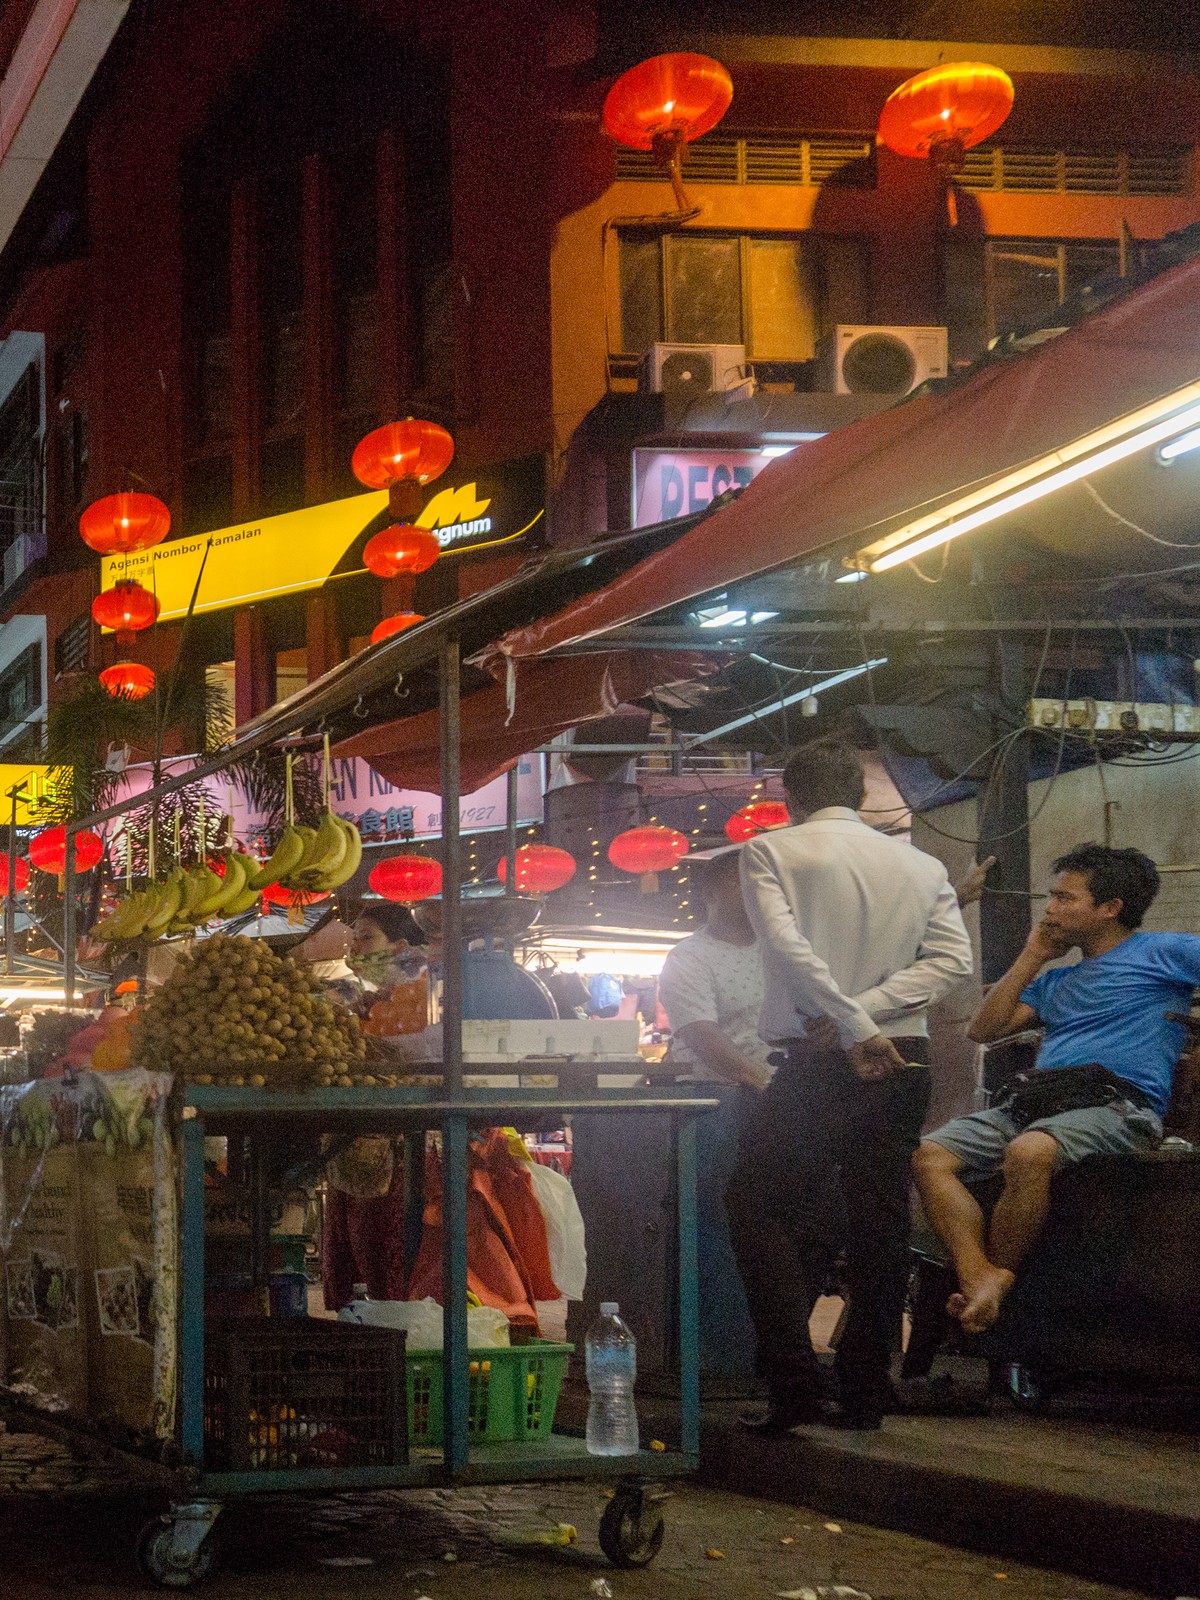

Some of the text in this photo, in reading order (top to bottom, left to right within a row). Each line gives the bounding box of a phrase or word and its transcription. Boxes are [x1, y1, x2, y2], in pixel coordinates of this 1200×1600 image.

[109, 552, 149, 572] Agensi
[153, 540, 203, 561] Nombor
[460, 805, 496, 823] 1927
